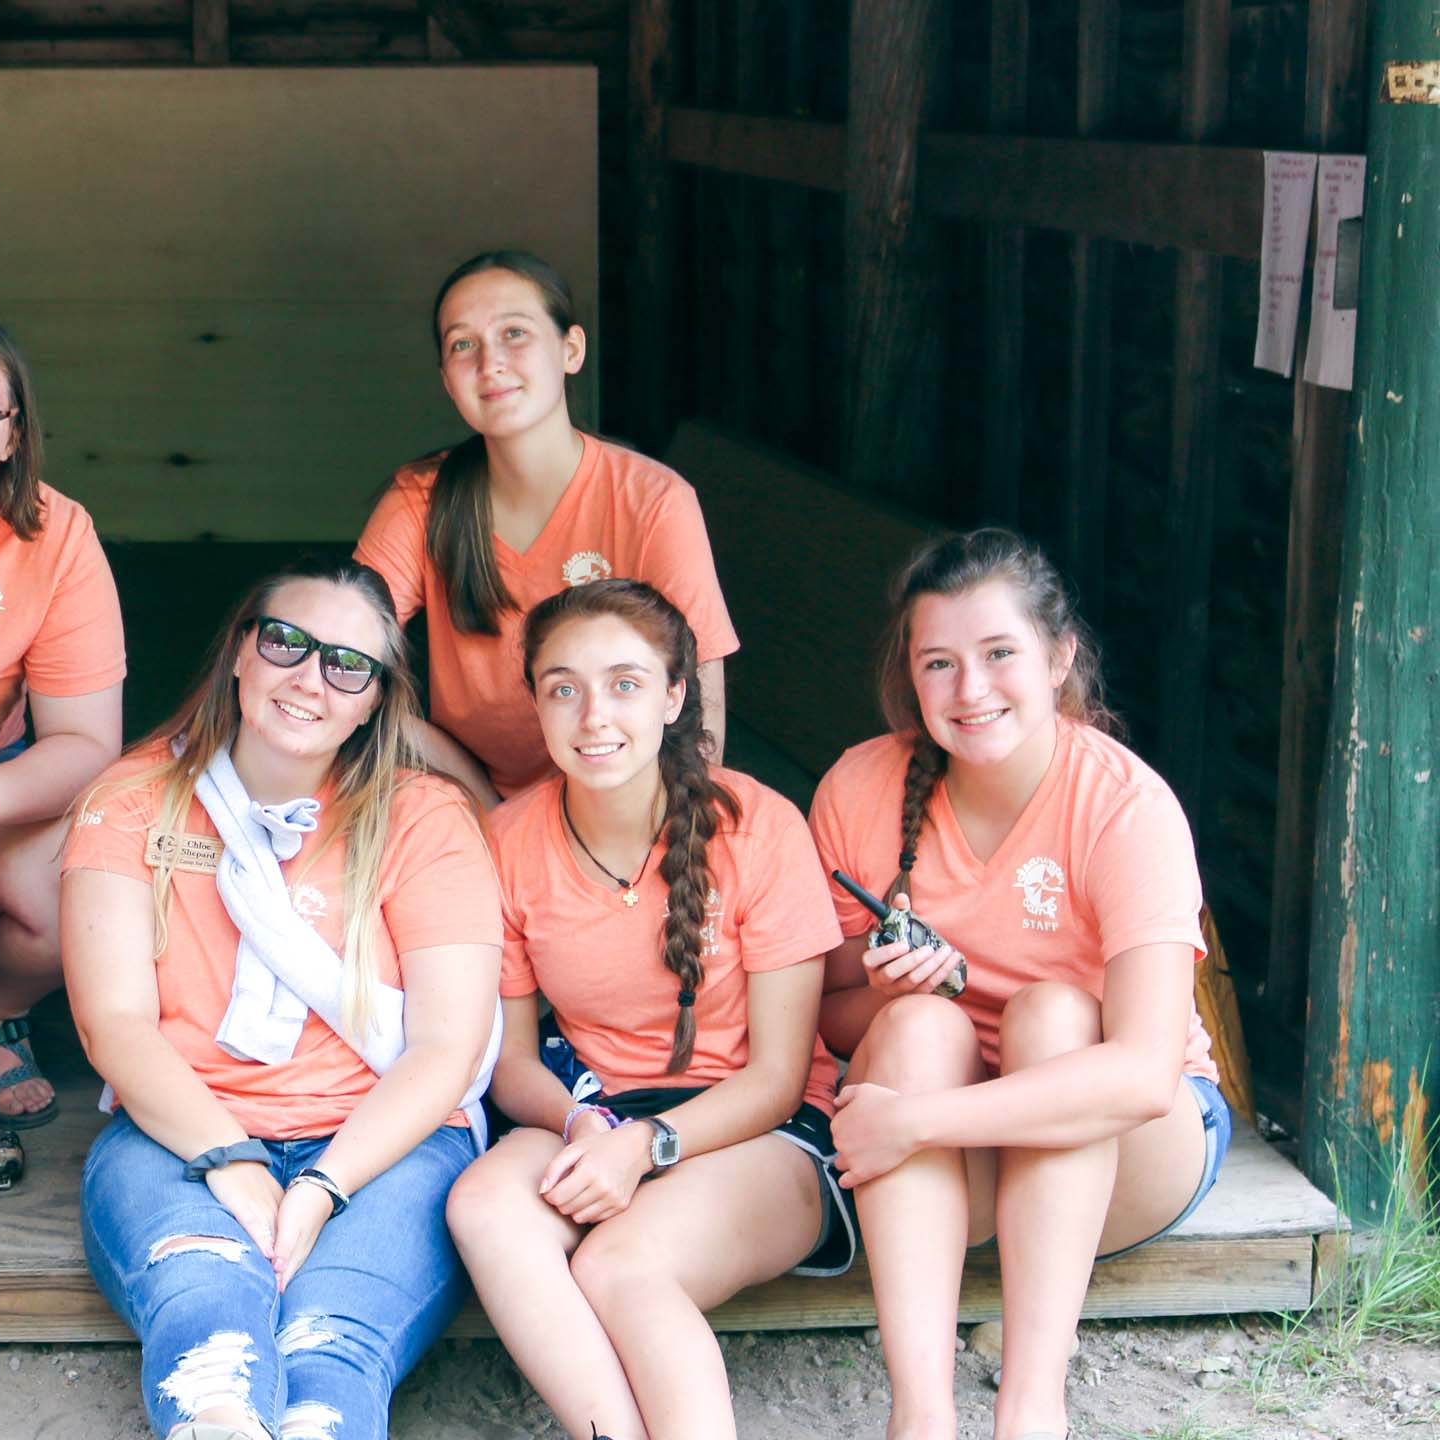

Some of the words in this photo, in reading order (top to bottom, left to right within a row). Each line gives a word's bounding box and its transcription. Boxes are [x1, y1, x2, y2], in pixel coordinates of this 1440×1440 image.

[187, 840, 212, 850] Chloe
[180, 848, 216, 860] Shepard
[1022, 918, 1059, 932] STAFF
